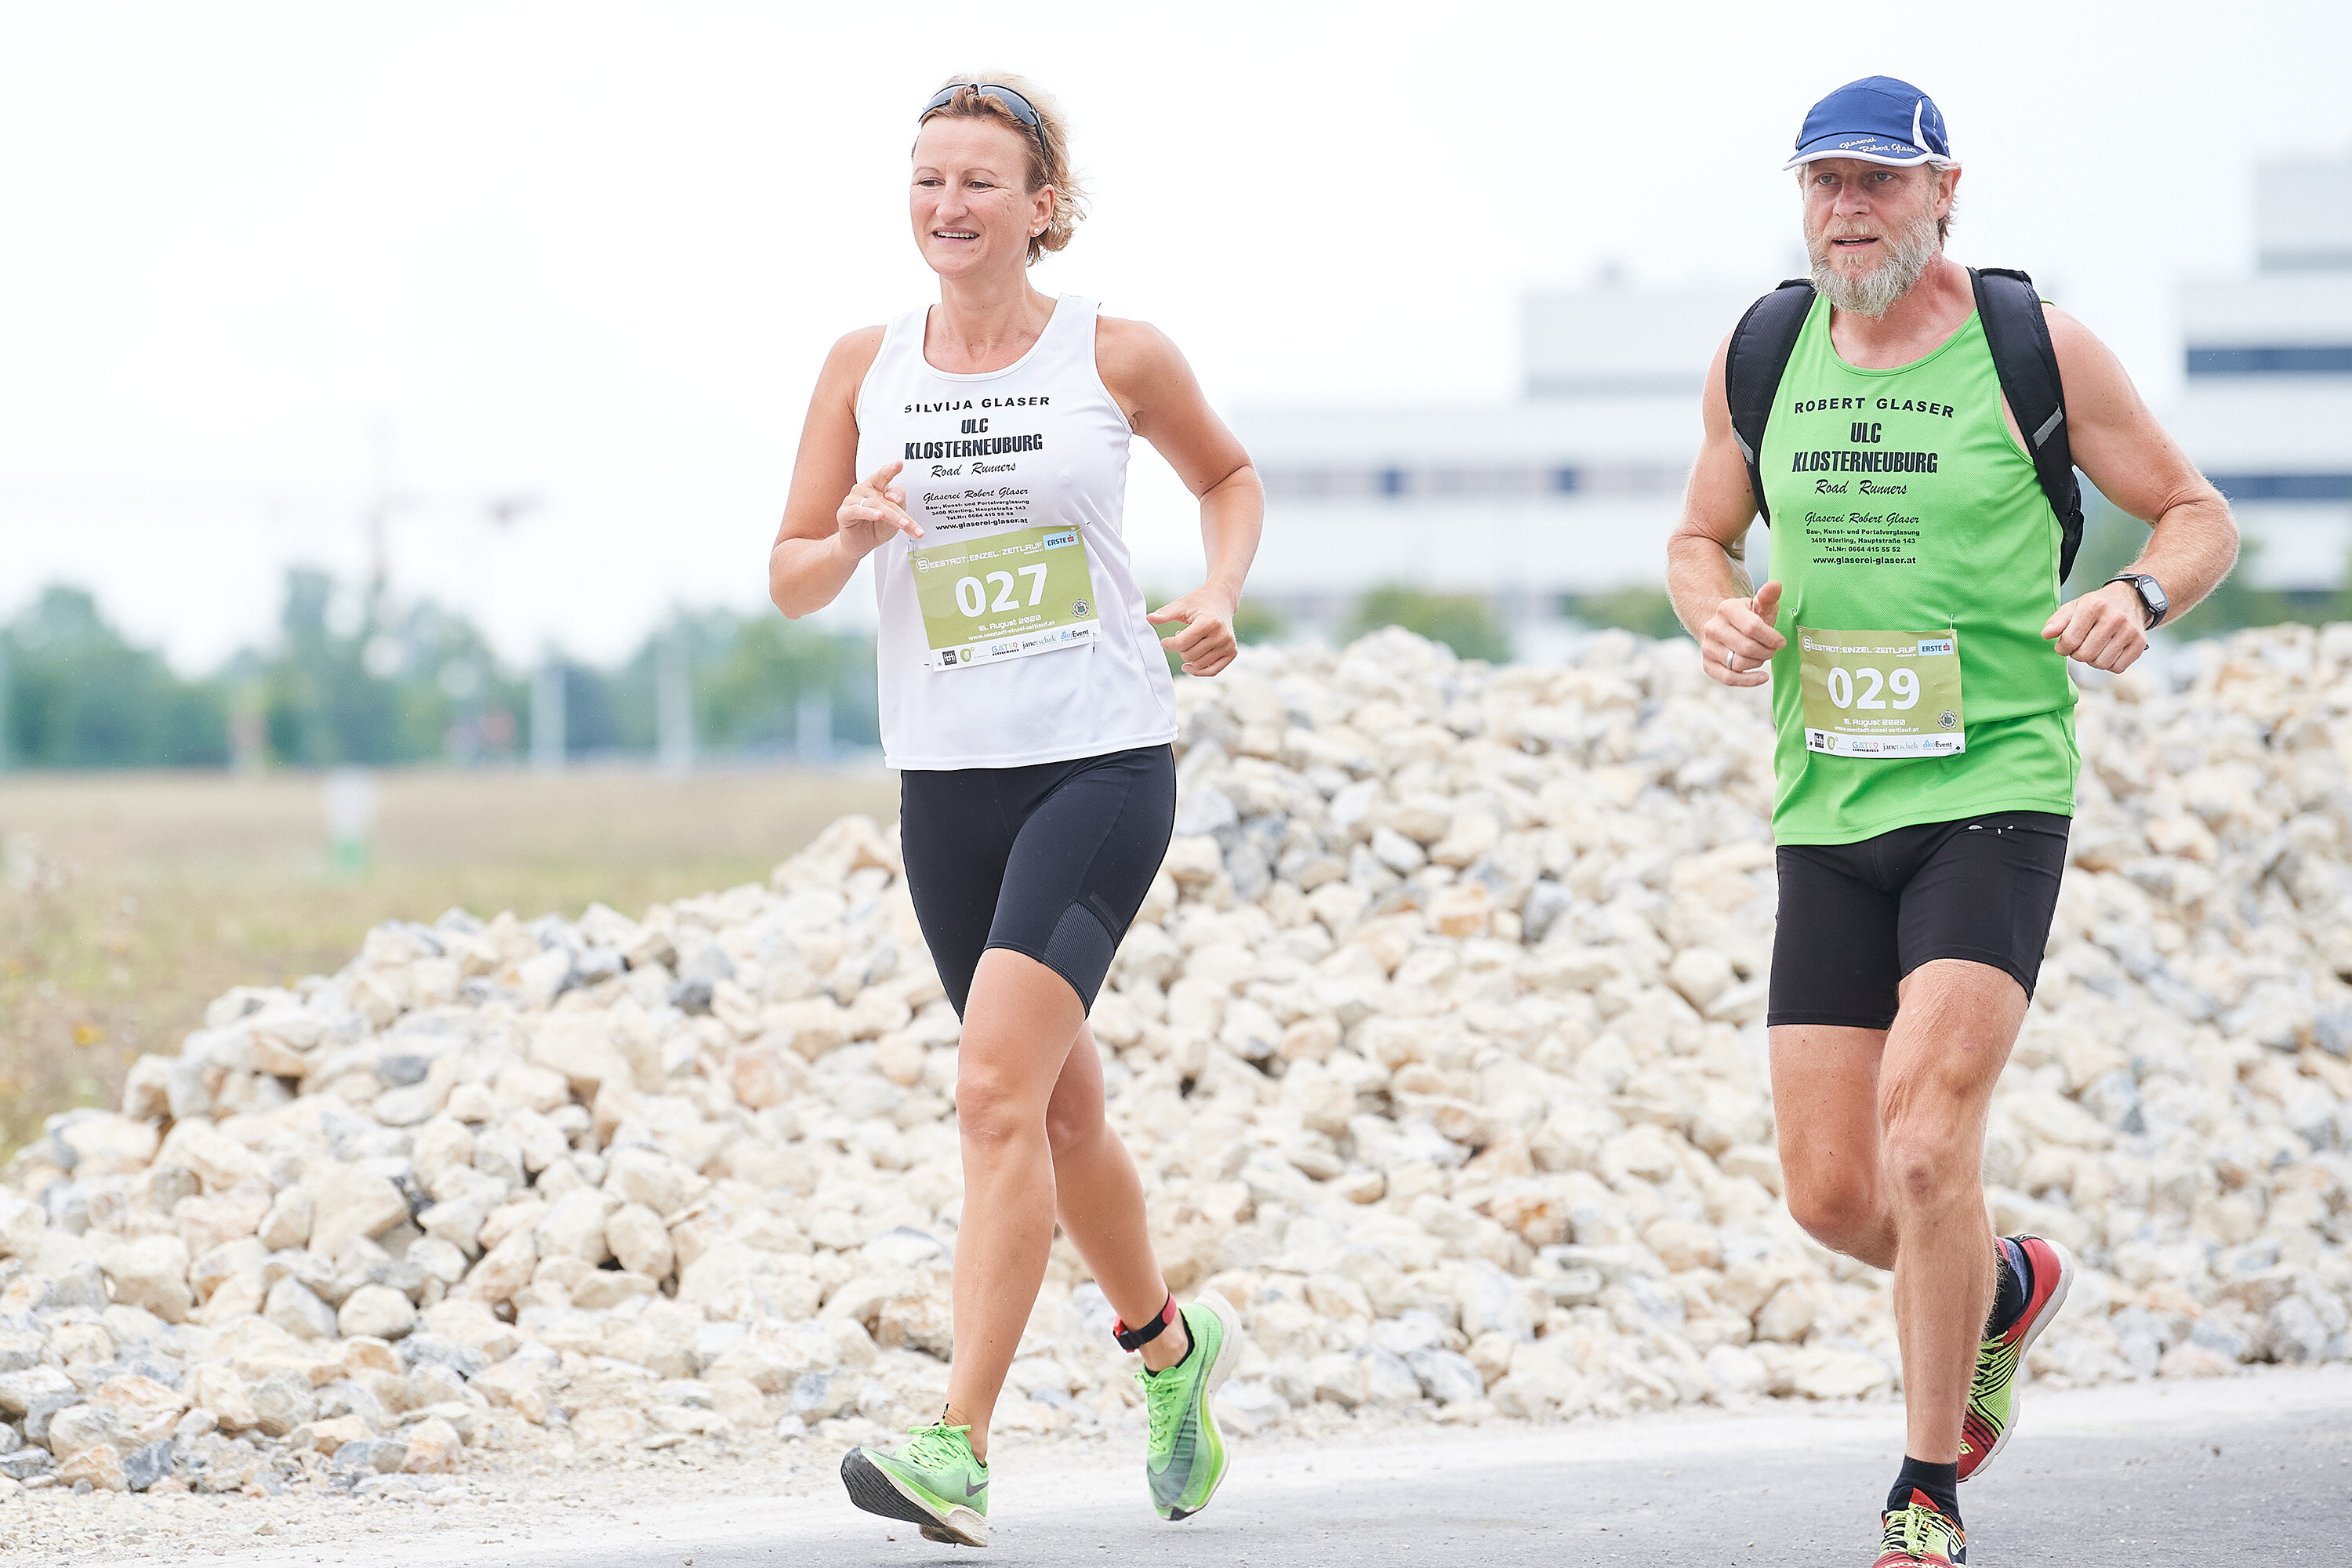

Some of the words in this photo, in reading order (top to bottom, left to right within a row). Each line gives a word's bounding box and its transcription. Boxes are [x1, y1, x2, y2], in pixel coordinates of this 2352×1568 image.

[1838, 137, 1877, 149] Glaserei
[1891, 143, 1918, 154] Glaser
[905, 400, 972, 413] SILVIJA
[982, 397, 1050, 408] GLASER
[1794, 397, 1866, 414] ROBERT
[1876, 398, 1955, 418] GLASER
[961, 418, 989, 434] ULC
[1850, 422, 1882, 444] ULC
[905, 434, 1043, 459] KLOSTERNEUBURG
[931, 464, 962, 478] Road
[971, 462, 1016, 475] Runners
[1792, 451, 1938, 473] KLOSTERNEUBURG
[1814, 479, 1849, 495] Road
[1859, 480, 1907, 495] Runners
[923, 492, 960, 504] Glaserei
[964, 489, 995, 499] Robert
[998, 487, 1029, 498] Glaser
[935, 517, 1028, 531] www.glaserei-glaser.at
[1805, 511, 1845, 526] Glaserei
[1849, 512, 1882, 524] Robert
[1886, 512, 1920, 527] Glaser
[1047, 538, 1068, 546] ERSTE
[1813, 556, 1916, 564] www.glaserei-glaser.at
[955, 562, 1048, 618] 027
[989, 619, 1018, 630] August
[1018, 614, 1042, 625] 2020
[967, 620, 1055, 641] www.seestadt-einzel-zeitlauf.at
[991, 641, 1018, 653] GATE9
[1022, 635, 1057, 650] janetschek
[1828, 667, 1920, 710] 029
[1852, 741, 1878, 750] GATE9
[1883, 742, 1918, 751] janetschek
